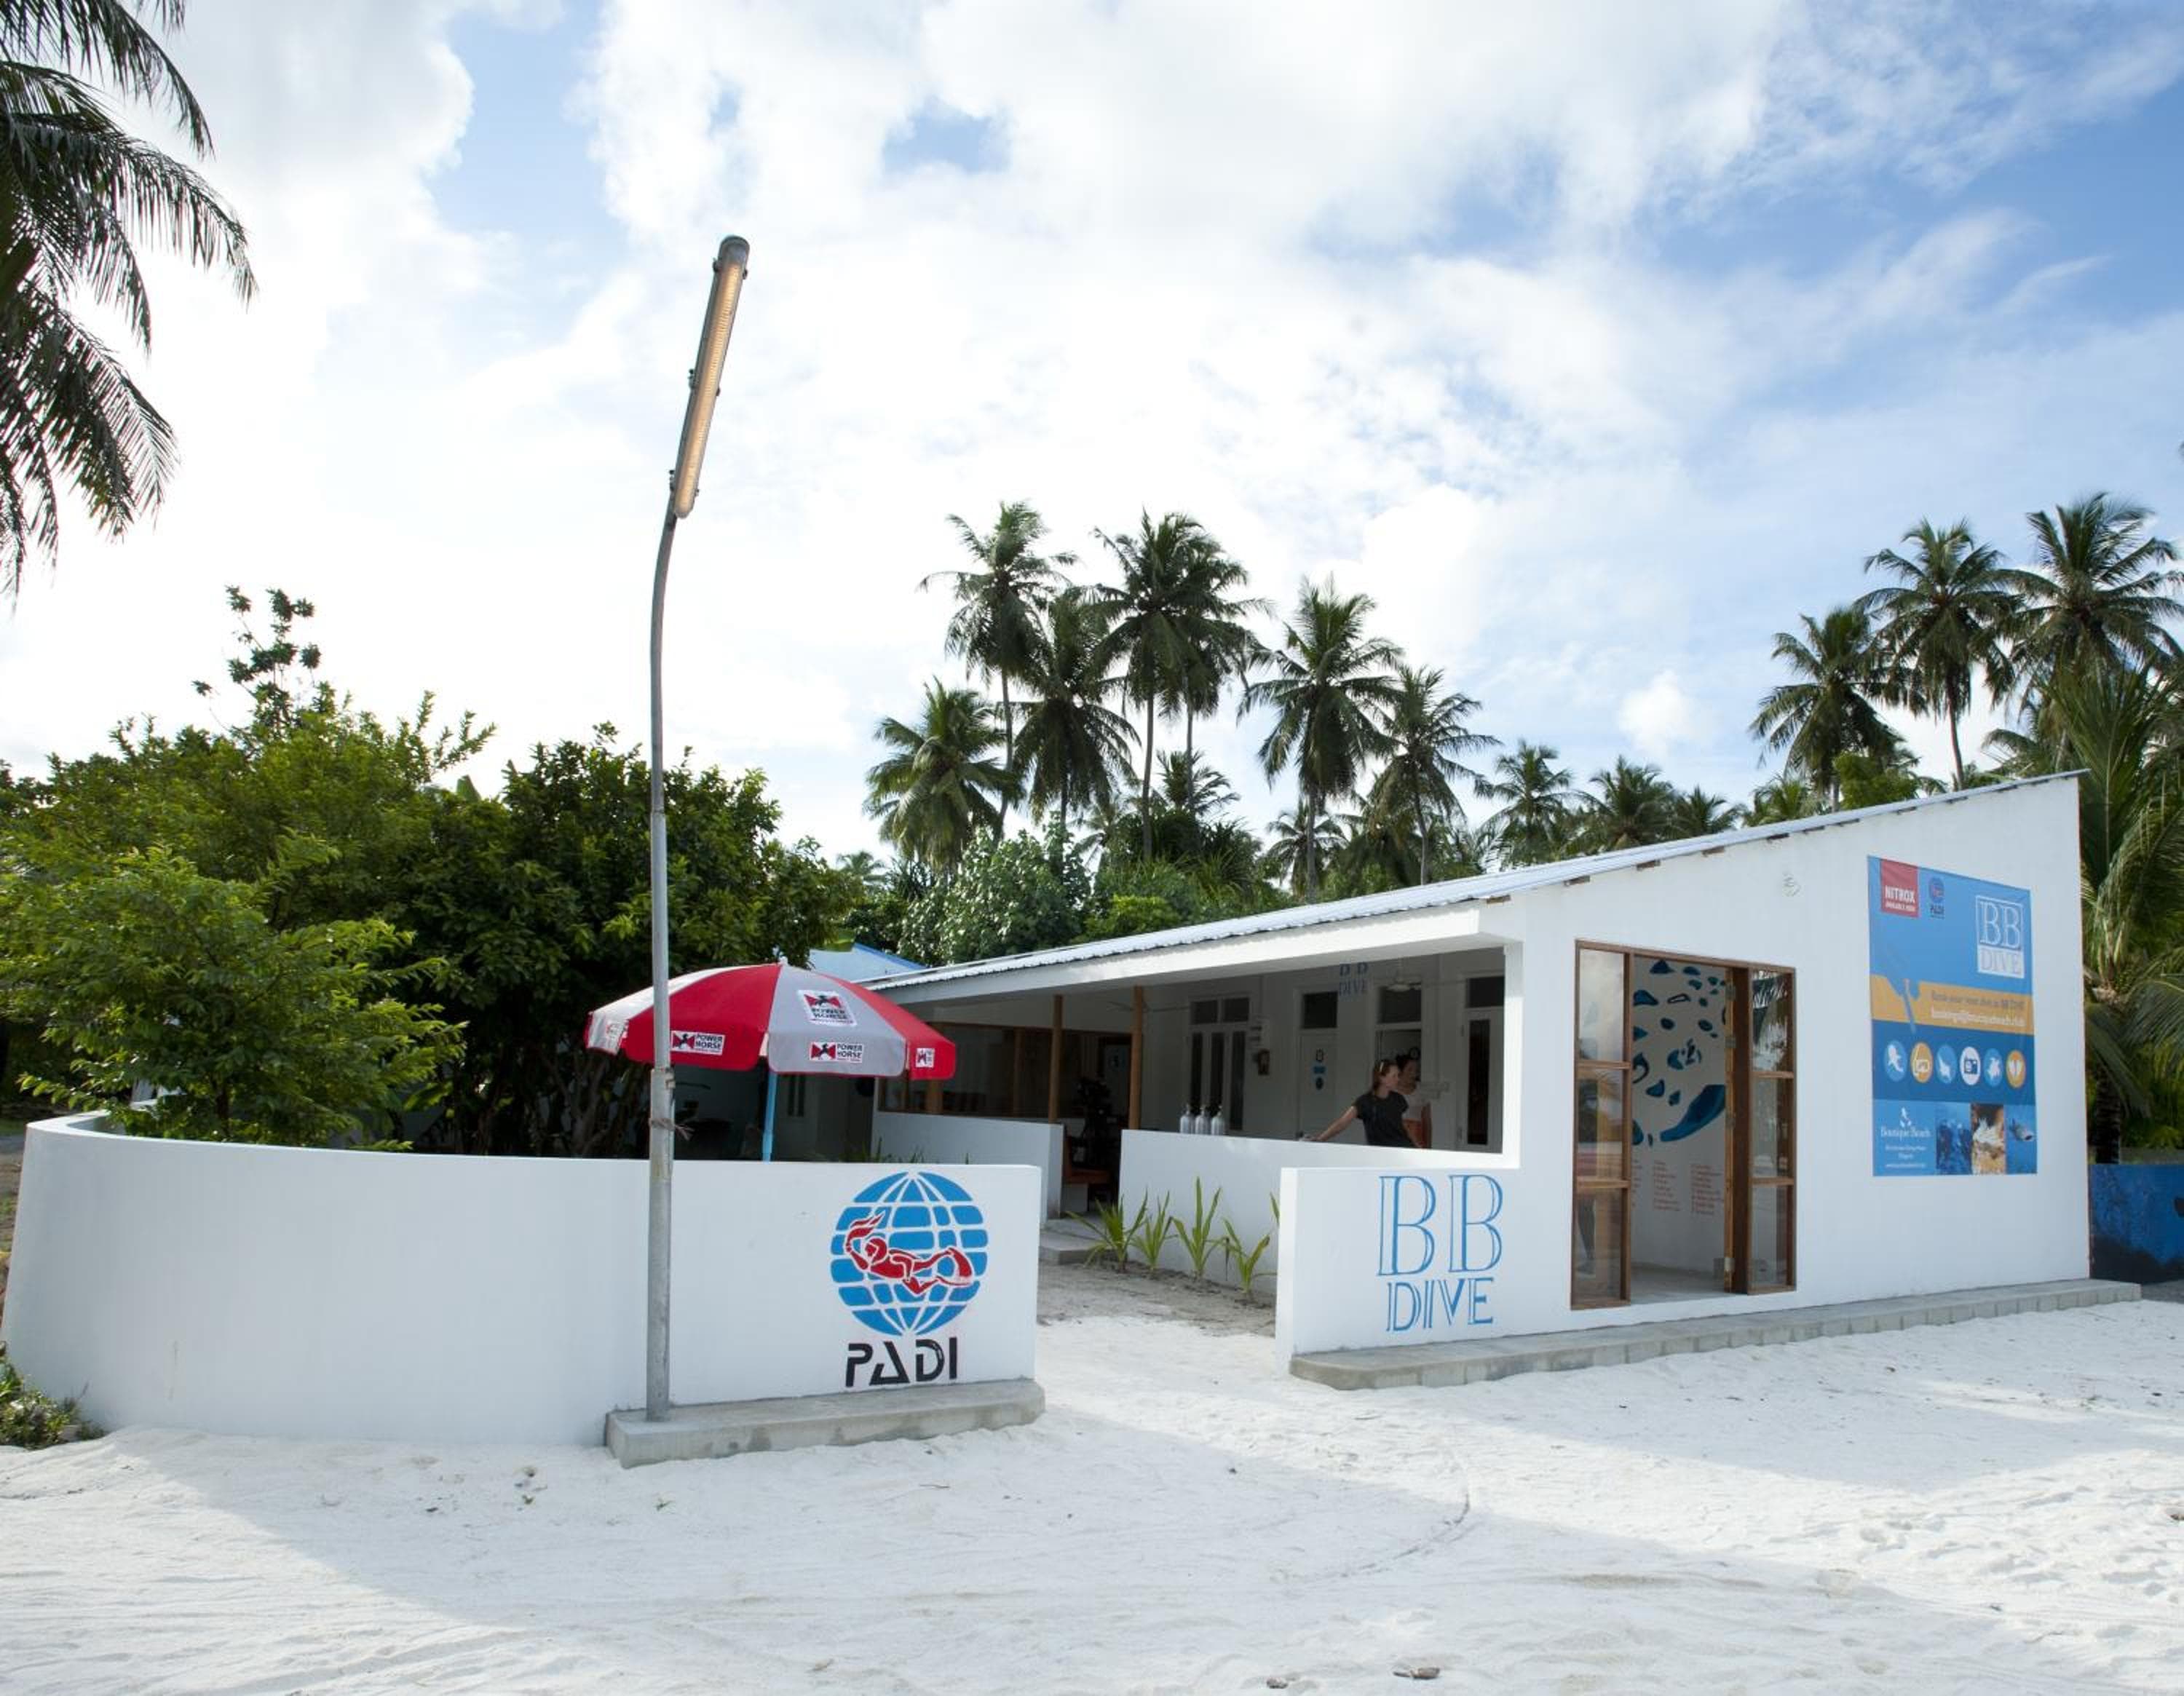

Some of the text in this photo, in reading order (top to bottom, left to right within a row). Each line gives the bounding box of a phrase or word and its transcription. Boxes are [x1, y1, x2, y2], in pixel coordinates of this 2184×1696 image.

[1885, 885, 1916, 903] NITROX
[1979, 901, 2021, 948] BB
[1981, 950, 2022, 974] DIVE
[696, 1034, 723, 1042] POWER
[696, 1041, 721, 1049] HORSE
[837, 1043, 863, 1051] POWER
[837, 1050, 862, 1058] HORSE
[1377, 1174, 1503, 1276] BB
[1385, 1277, 1495, 1333] DIVE
[845, 1336, 957, 1388] PADI
